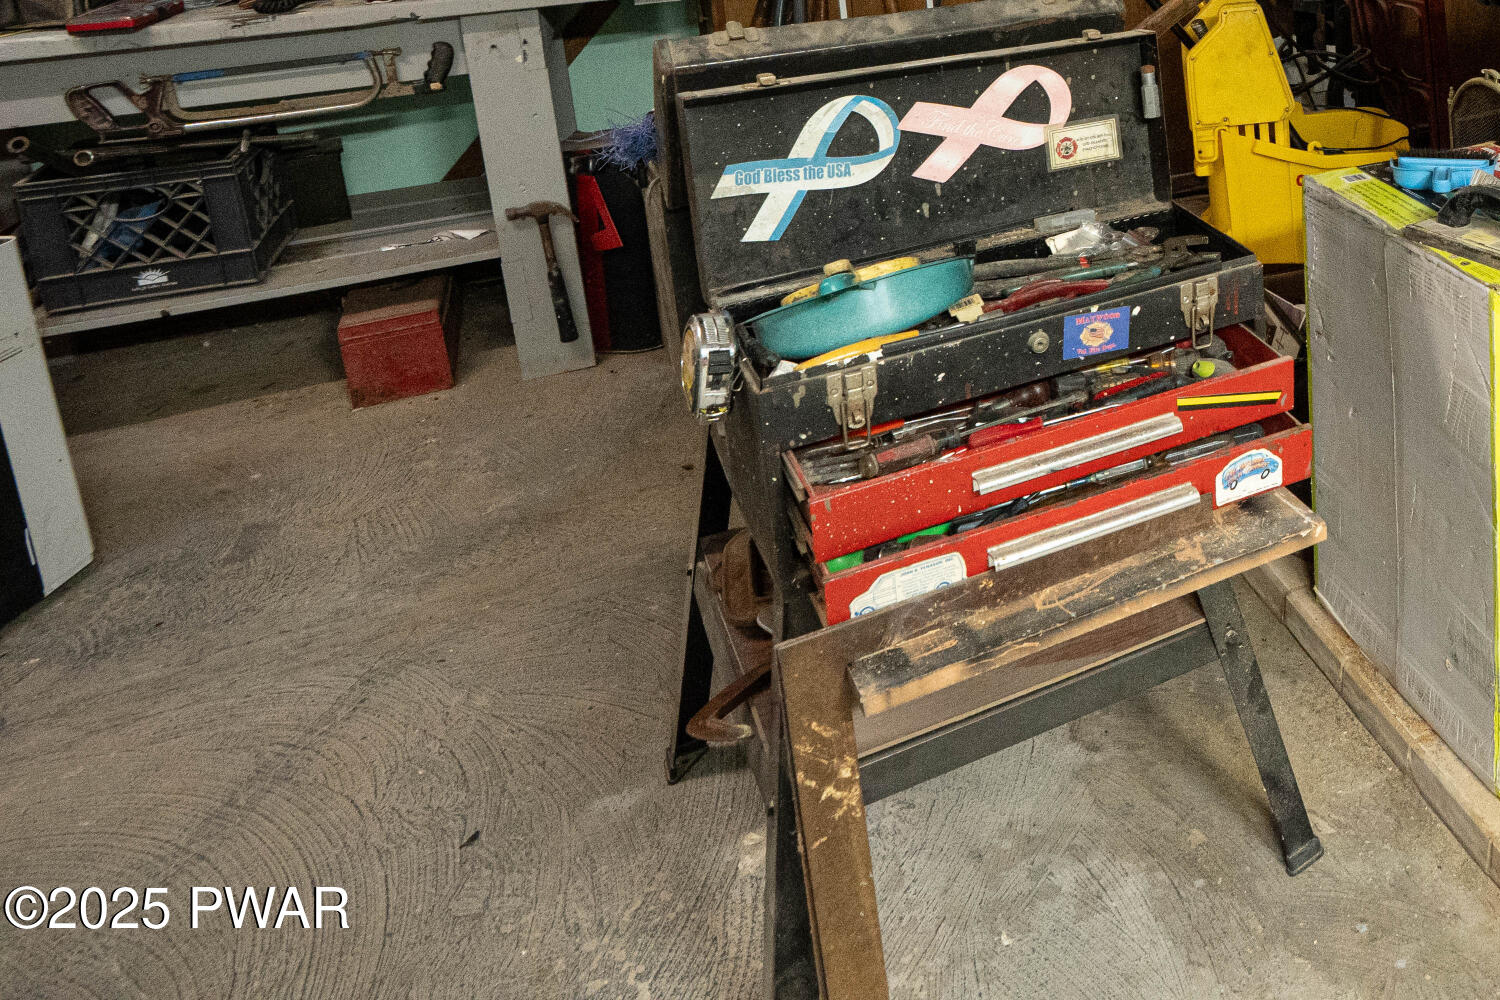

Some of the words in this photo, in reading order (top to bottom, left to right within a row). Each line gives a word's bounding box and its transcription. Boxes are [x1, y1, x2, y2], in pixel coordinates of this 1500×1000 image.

[963, 121, 984, 138] the
[734, 168, 761, 186] God
[763, 166, 801, 184] Bless
[803, 165, 824, 180] the
[827, 162, 852, 179] USA
